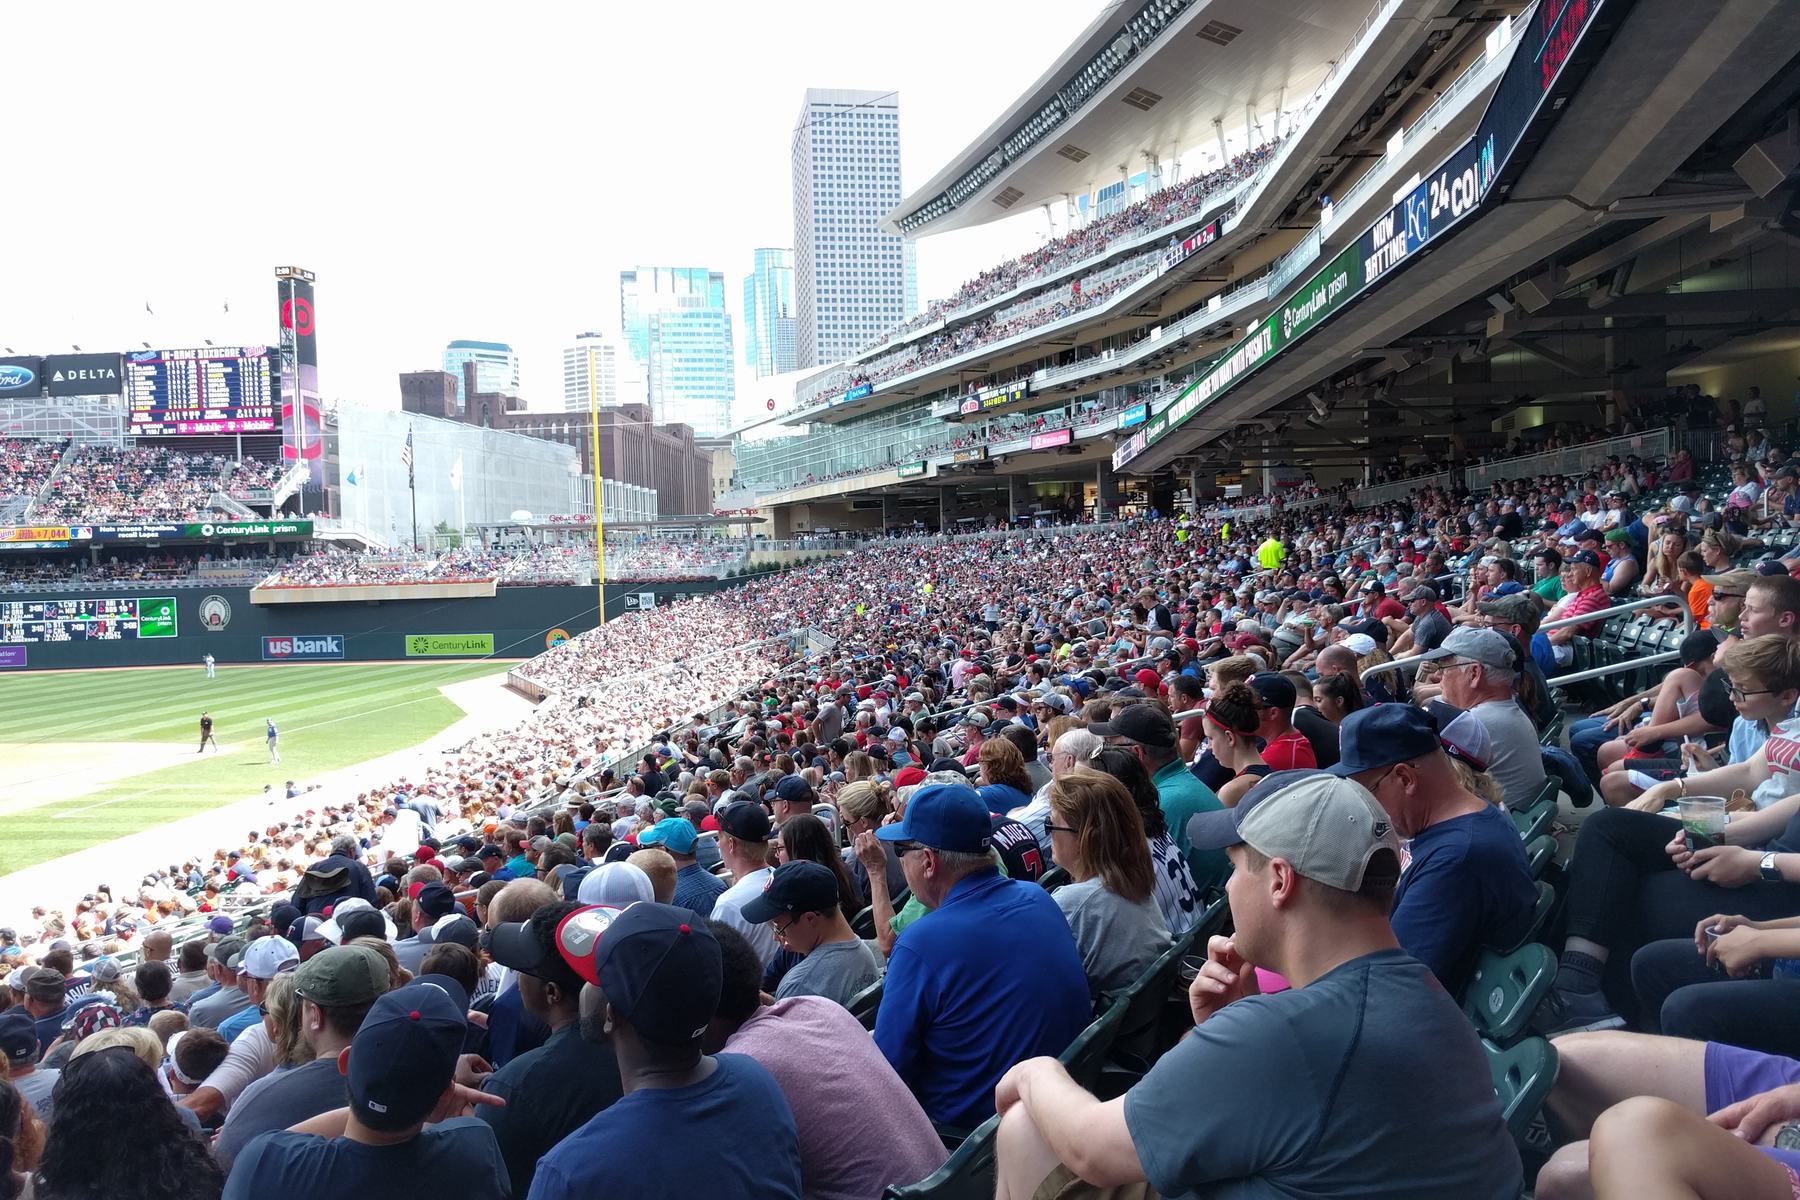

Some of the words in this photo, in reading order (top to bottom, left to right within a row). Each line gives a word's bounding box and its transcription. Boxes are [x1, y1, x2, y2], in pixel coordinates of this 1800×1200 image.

[1430, 171, 1450, 220] 24
[1373, 209, 1394, 251] NOW
[1406, 193, 1427, 242] KC
[1364, 230, 1408, 284] BATTING
[1291, 284, 1327, 328] CenturyLink
[1328, 271, 1348, 305] prism
[1246, 332, 1264, 368] PRISM
[0, 372, 22, 385] ord
[68, 368, 115, 380] DELTA
[216, 525, 269, 535] CenturyLink
[272, 525, 297, 534] prism
[432, 640, 486, 651] CenturyLink
[1021, 848, 1043, 882] 7
